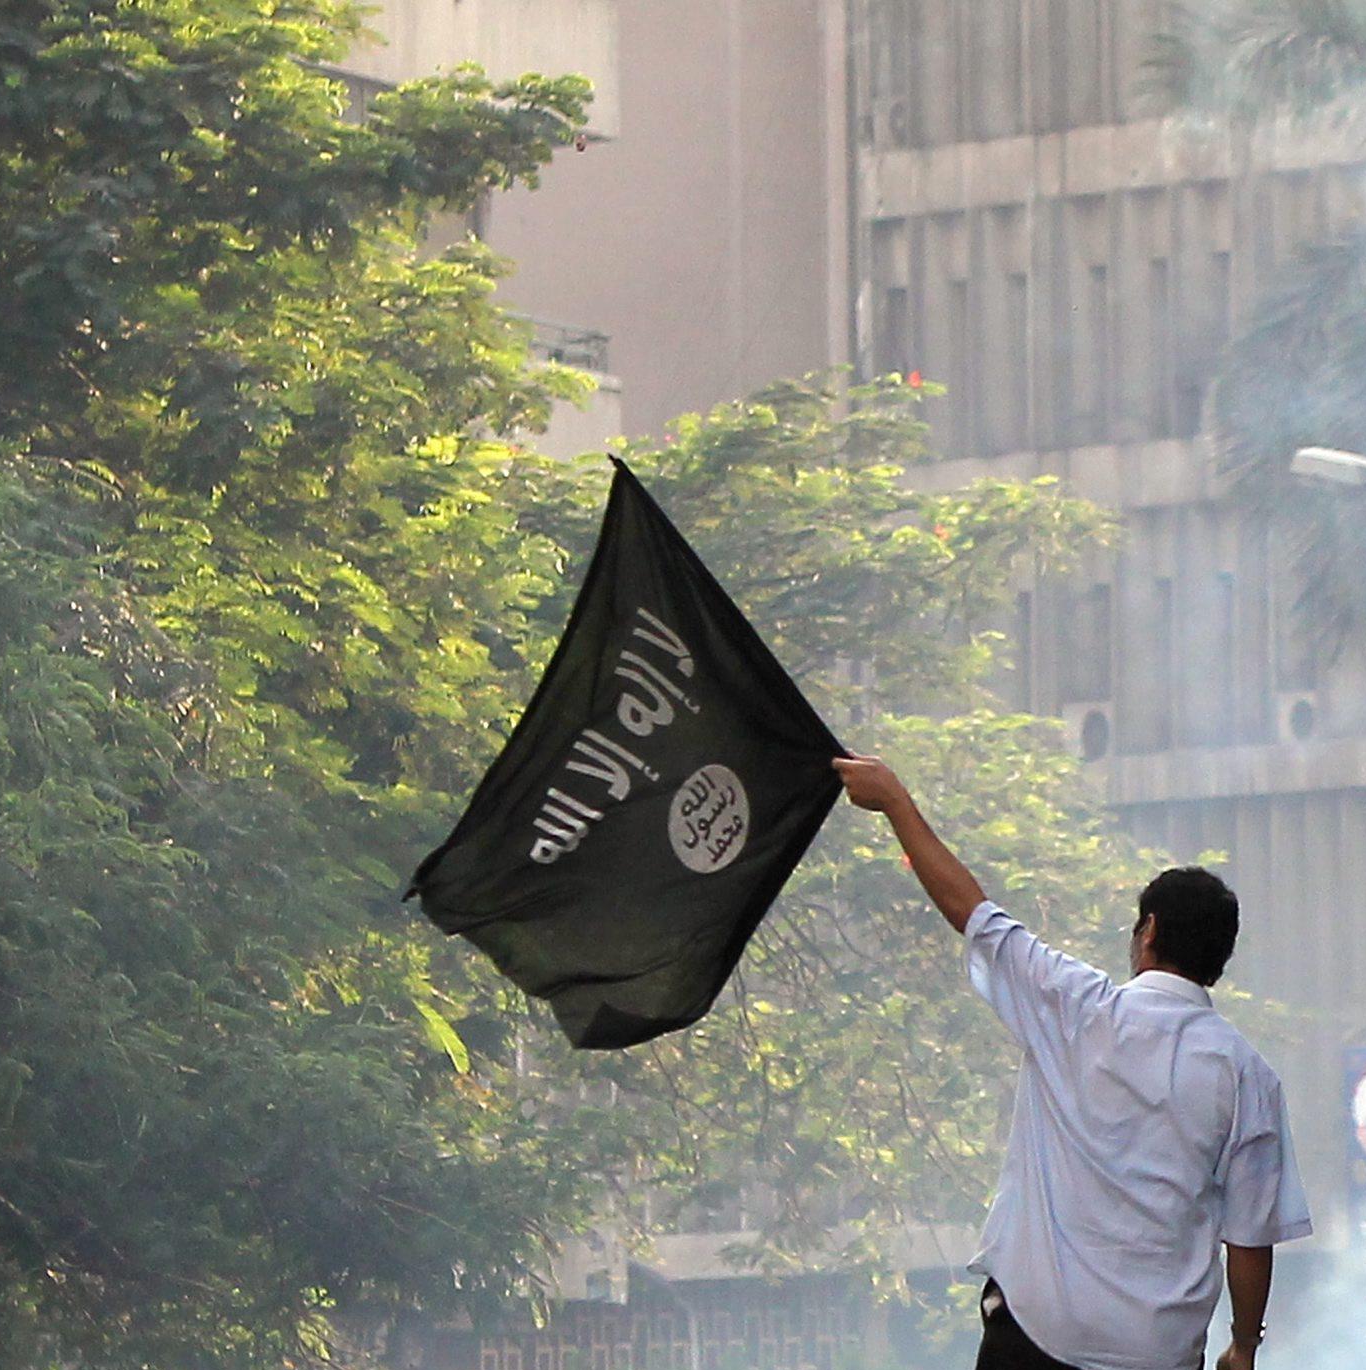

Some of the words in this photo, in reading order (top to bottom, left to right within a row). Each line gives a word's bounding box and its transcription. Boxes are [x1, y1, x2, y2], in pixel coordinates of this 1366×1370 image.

[632, 607, 695, 677] لا
[614, 650, 700, 738] إله
[565, 729, 660, 802] إلا
[680, 770, 717, 817] الله
[529, 787, 604, 865] الله
[681, 785, 737, 849] رسول
[705, 814, 744, 864] محمد
